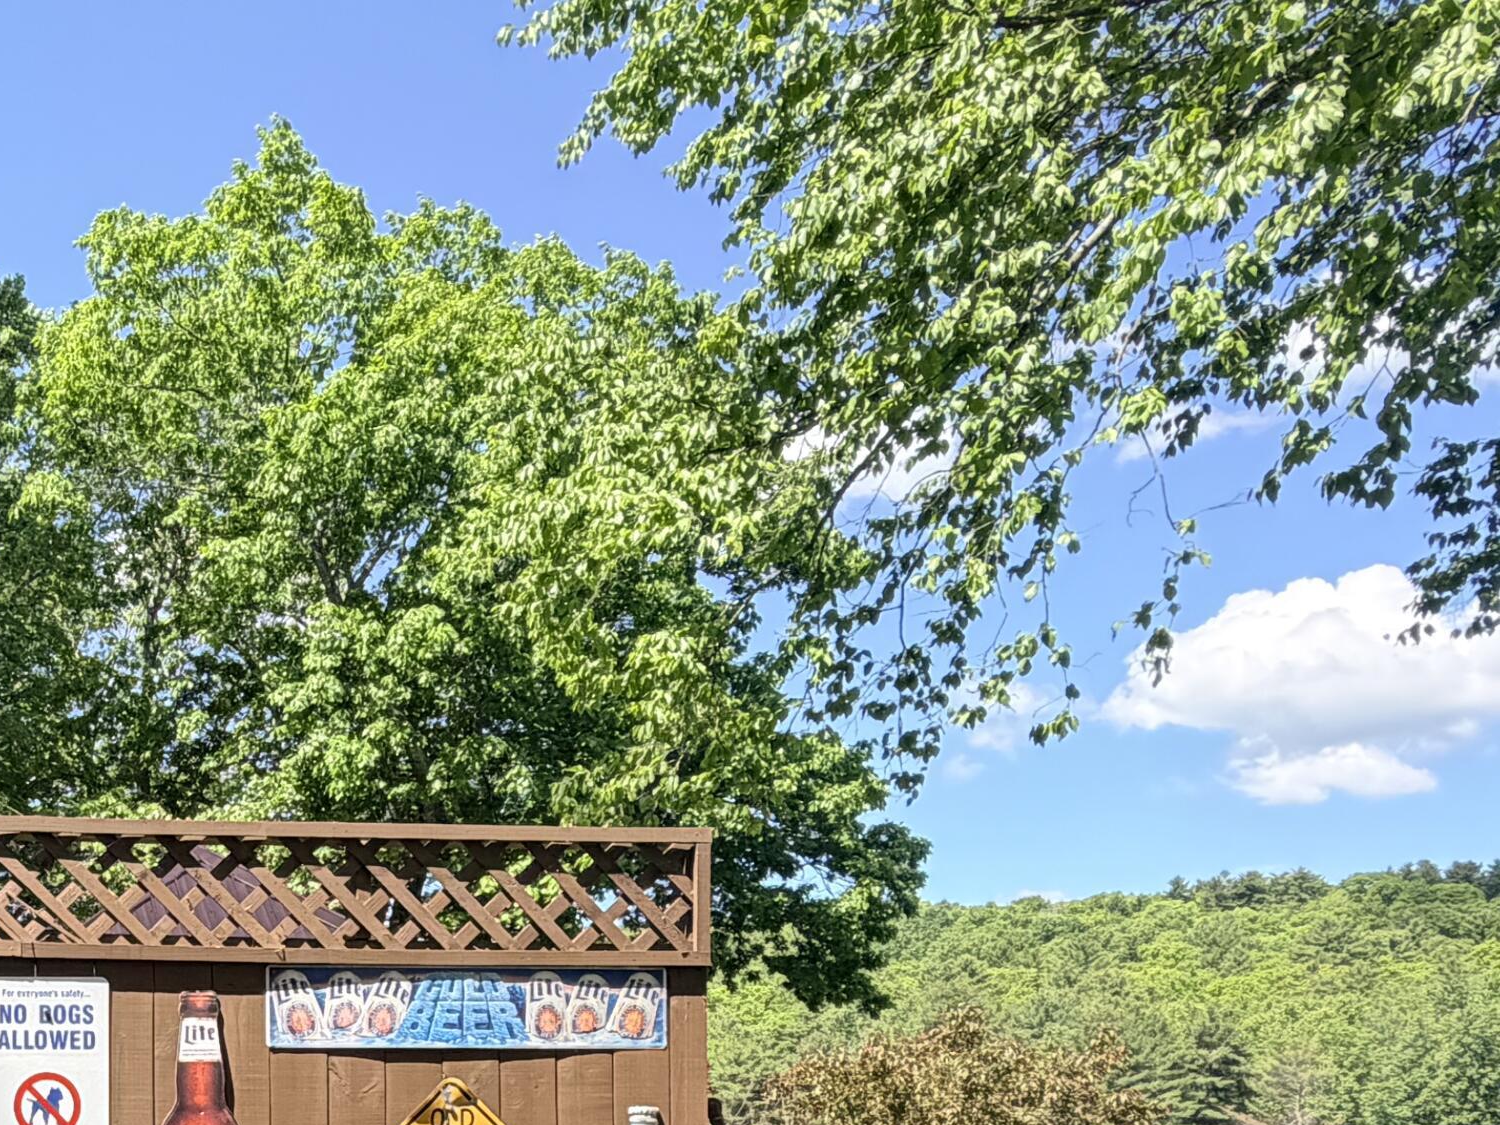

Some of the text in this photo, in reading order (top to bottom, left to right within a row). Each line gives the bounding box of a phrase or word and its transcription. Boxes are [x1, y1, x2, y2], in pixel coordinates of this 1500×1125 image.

[2, 989, 14, 997] For
[17, 989, 58, 998] everyone's
[0, 1003, 27, 1024] NO
[399, 1000, 527, 1041] BEER
[185, 1025, 215, 1045] Lite
